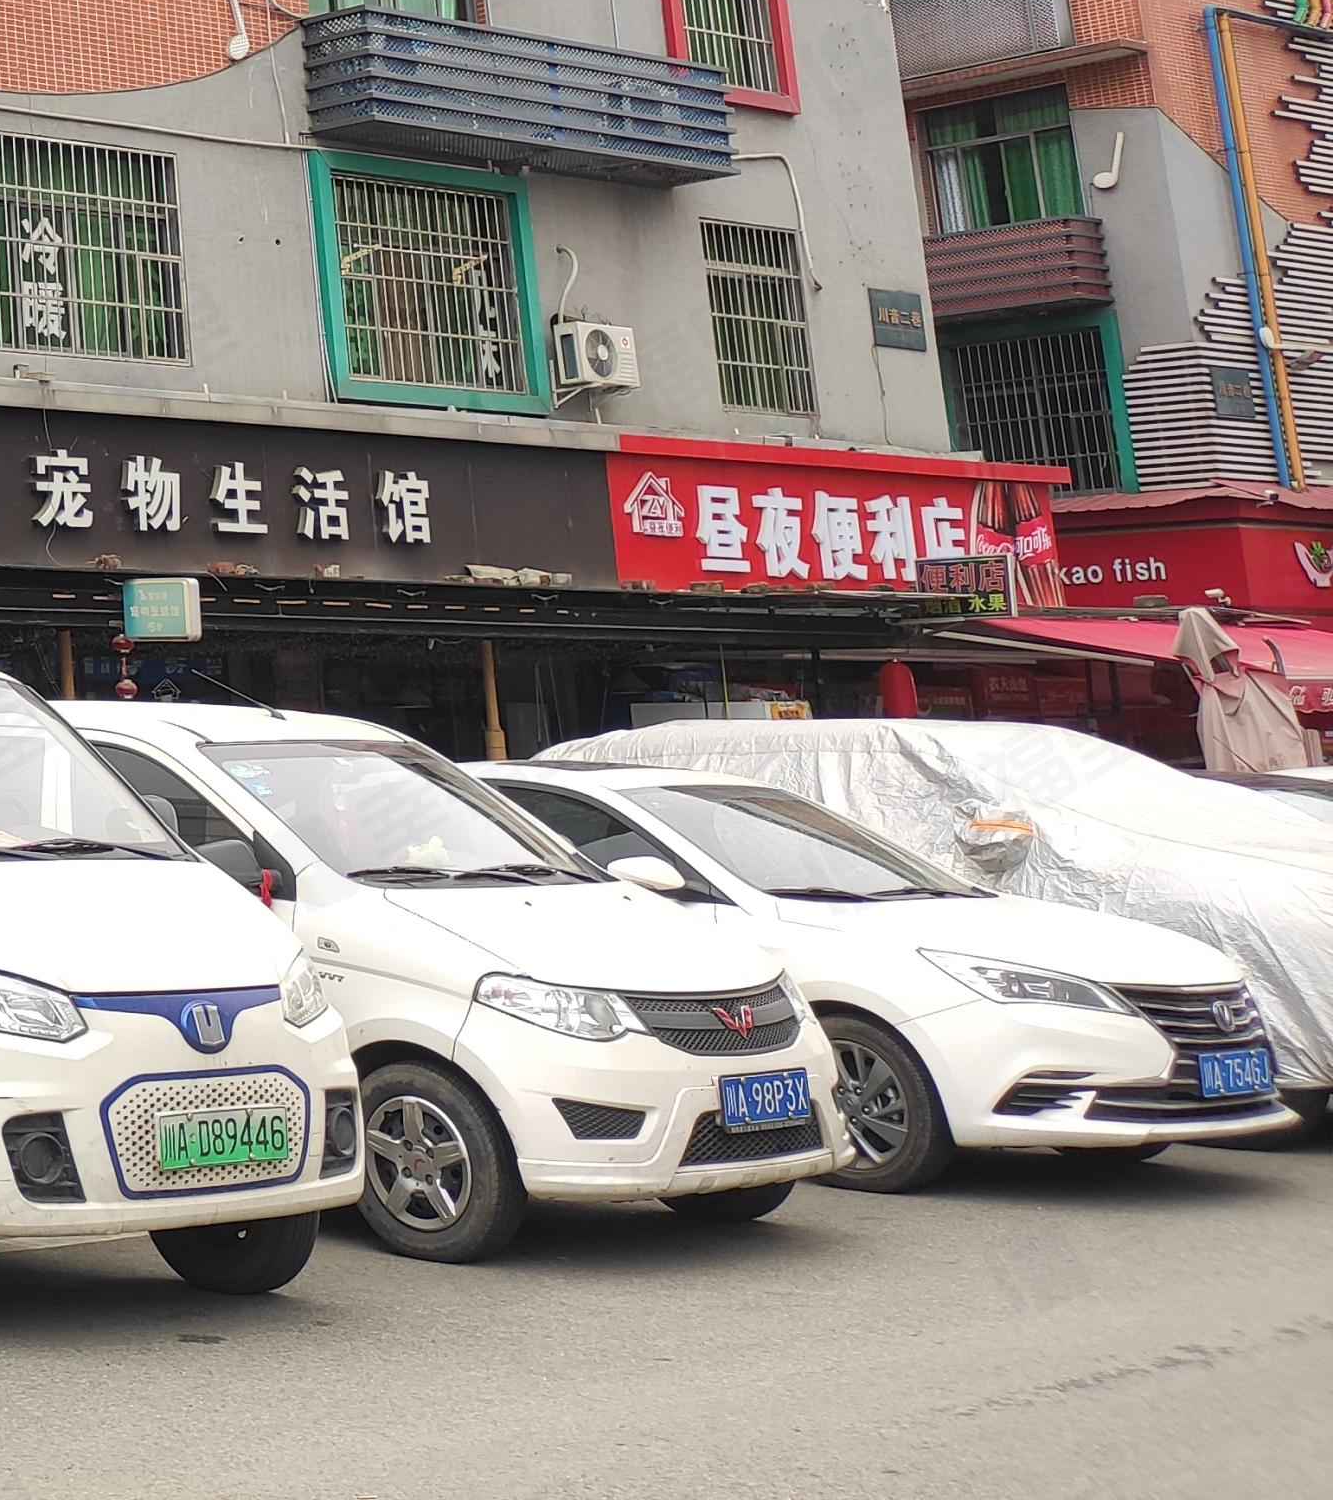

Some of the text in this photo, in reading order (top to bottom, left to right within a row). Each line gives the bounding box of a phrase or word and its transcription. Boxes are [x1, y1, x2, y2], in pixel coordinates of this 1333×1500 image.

[21, 217, 67, 340] 冷暖
[878, 306, 922, 328] 川音二巷
[31, 449, 431, 544] 宠物生活馆
[696, 483, 966, 581] 昼夜便利店
[921, 561, 1005, 593] 便利店
[1113, 556, 1167, 583] fish
